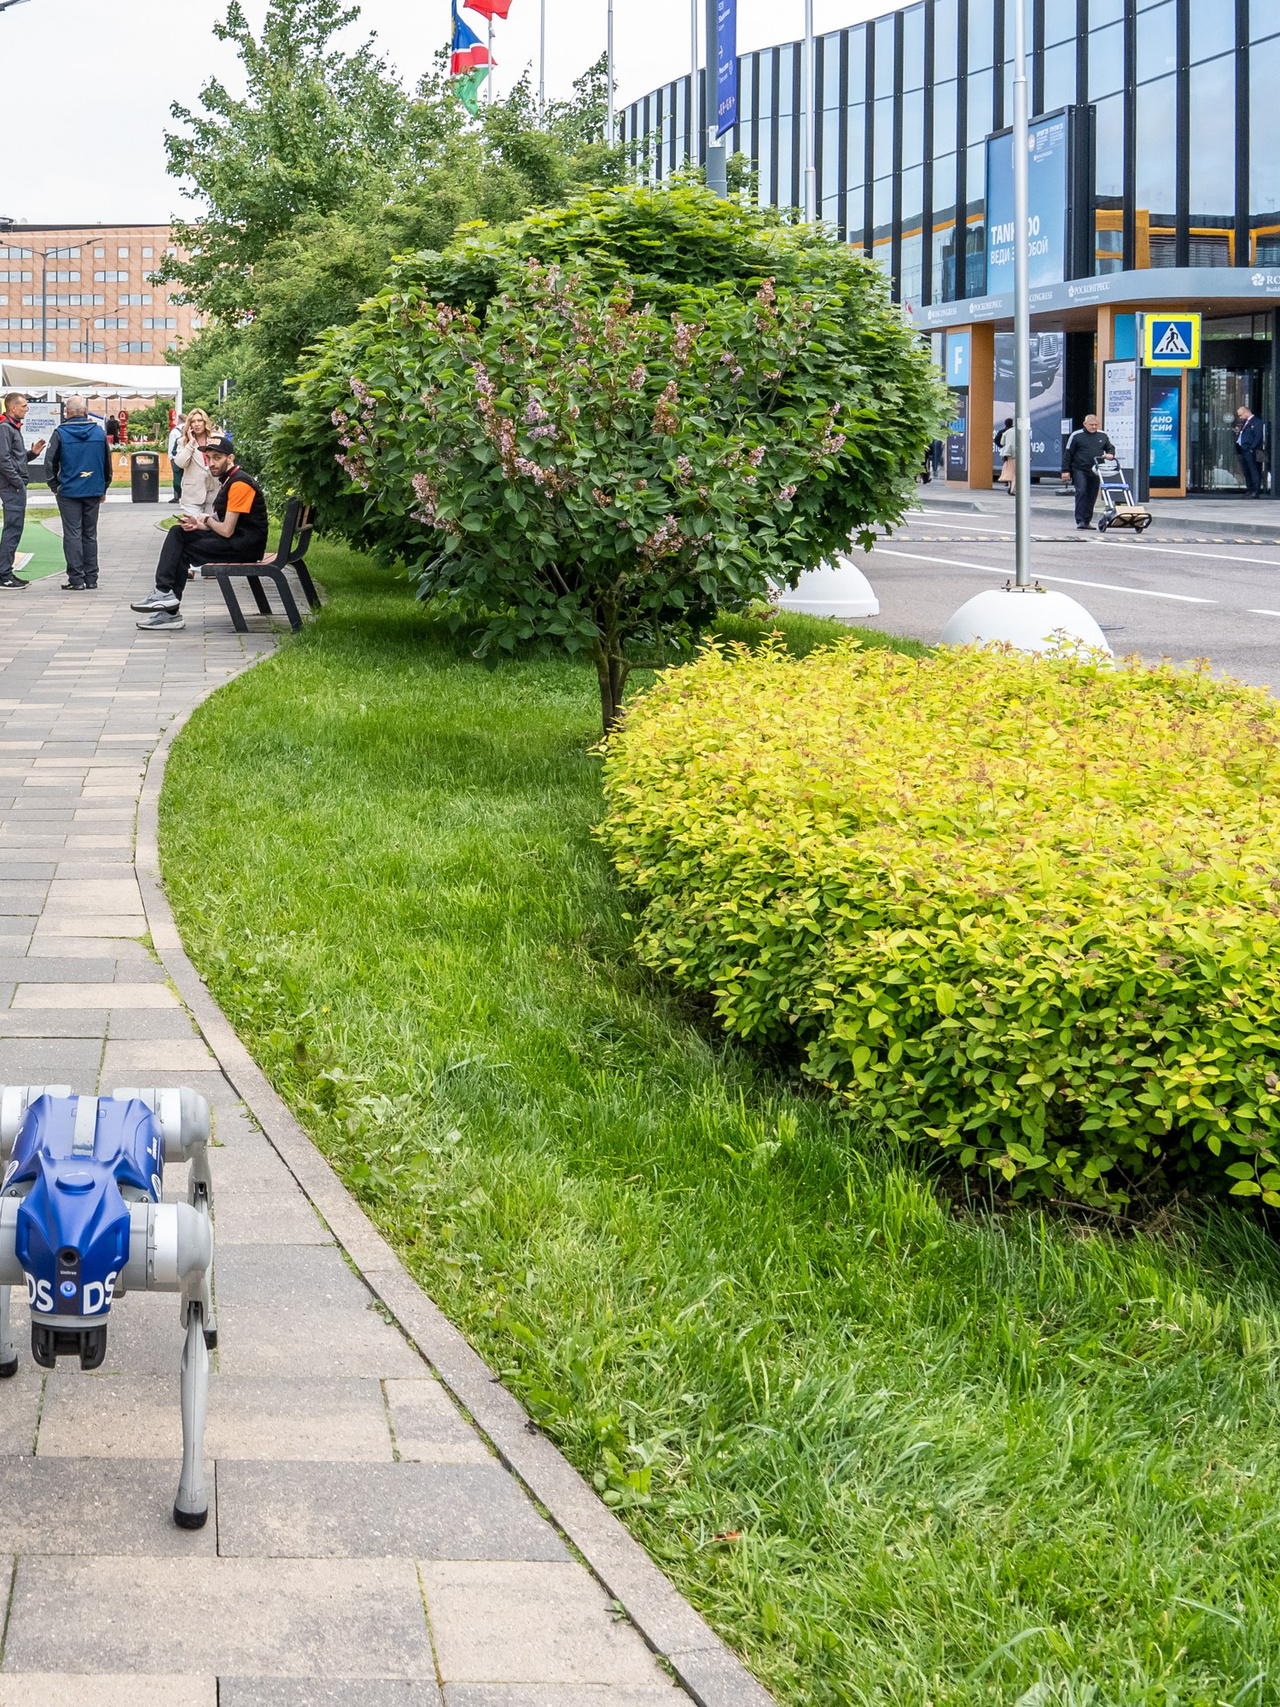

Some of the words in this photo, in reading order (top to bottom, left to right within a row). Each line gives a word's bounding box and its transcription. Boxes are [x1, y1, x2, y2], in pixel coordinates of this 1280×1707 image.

[990, 248, 1010, 266] ВЕДИ
[954, 346, 963, 375] F
[1151, 416, 1172, 424] АНО
[1151, 424, 1173, 432] СИИ
